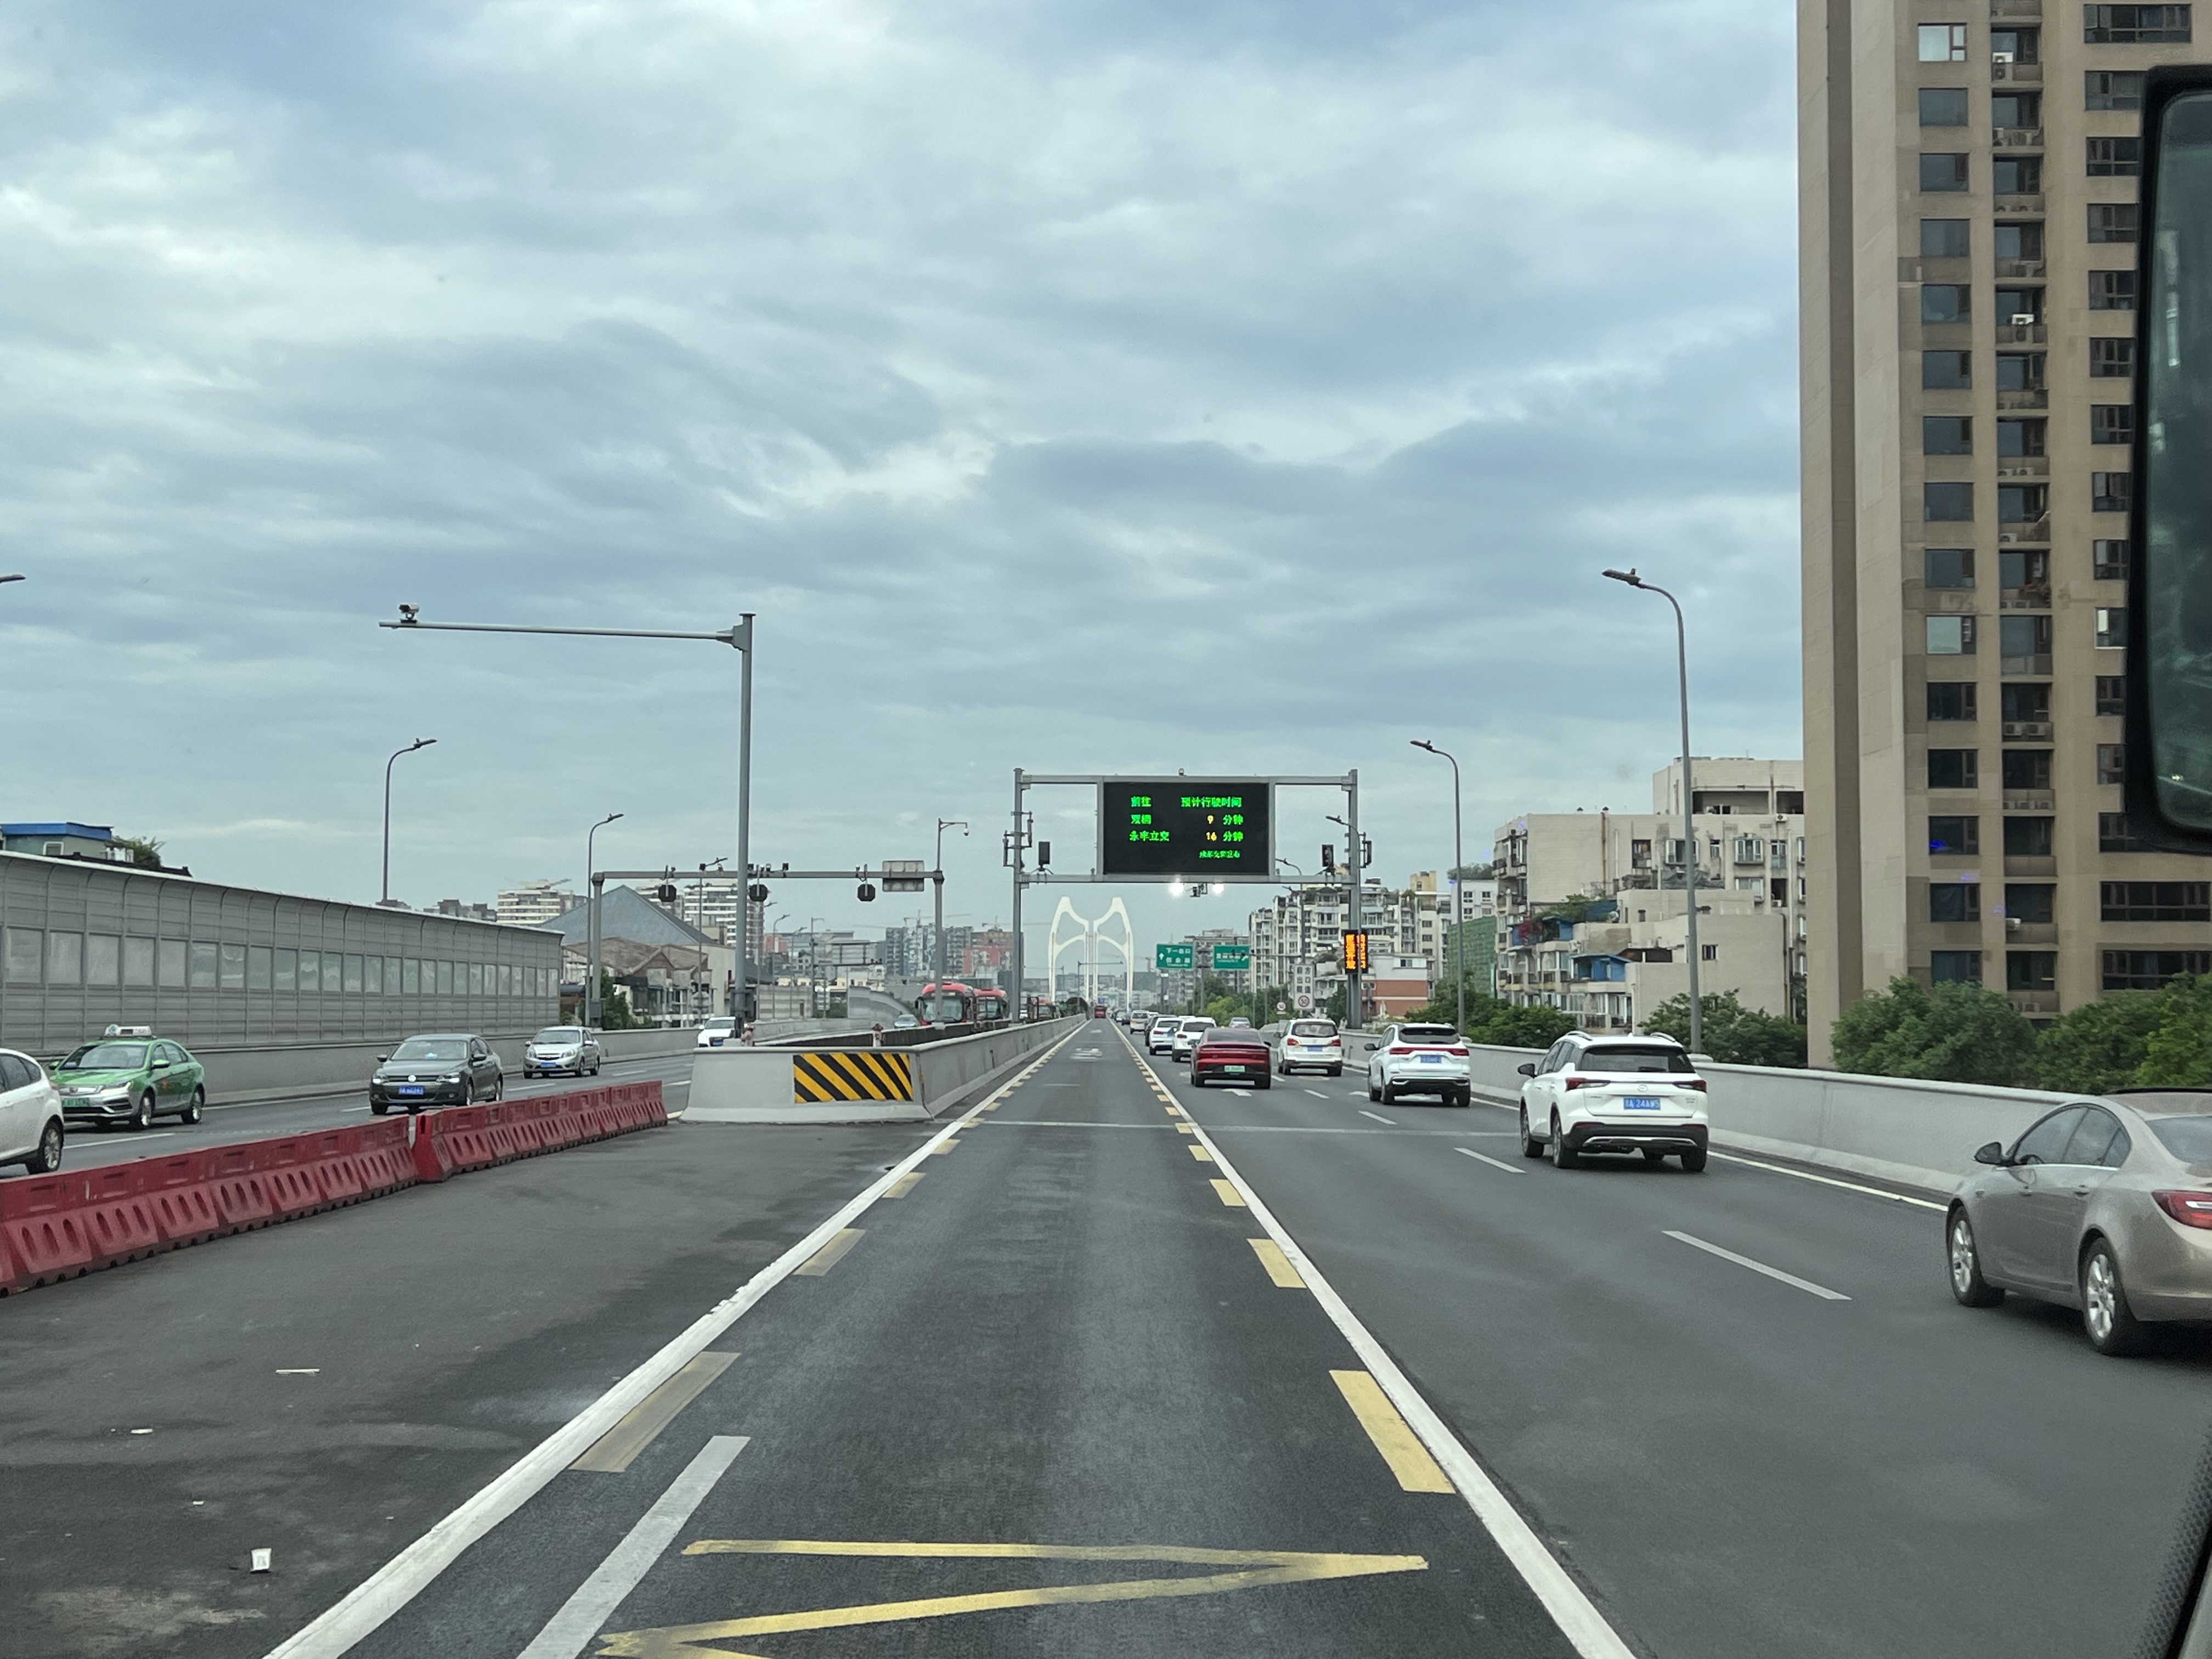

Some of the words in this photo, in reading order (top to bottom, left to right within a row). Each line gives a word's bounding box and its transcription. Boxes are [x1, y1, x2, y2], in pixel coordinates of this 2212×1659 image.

[1207, 815, 1214, 824] 9
[1222, 814, 1244, 825] 分钟
[1206, 832, 1217, 842] 16
[1223, 831, 1244, 842] 分钟
